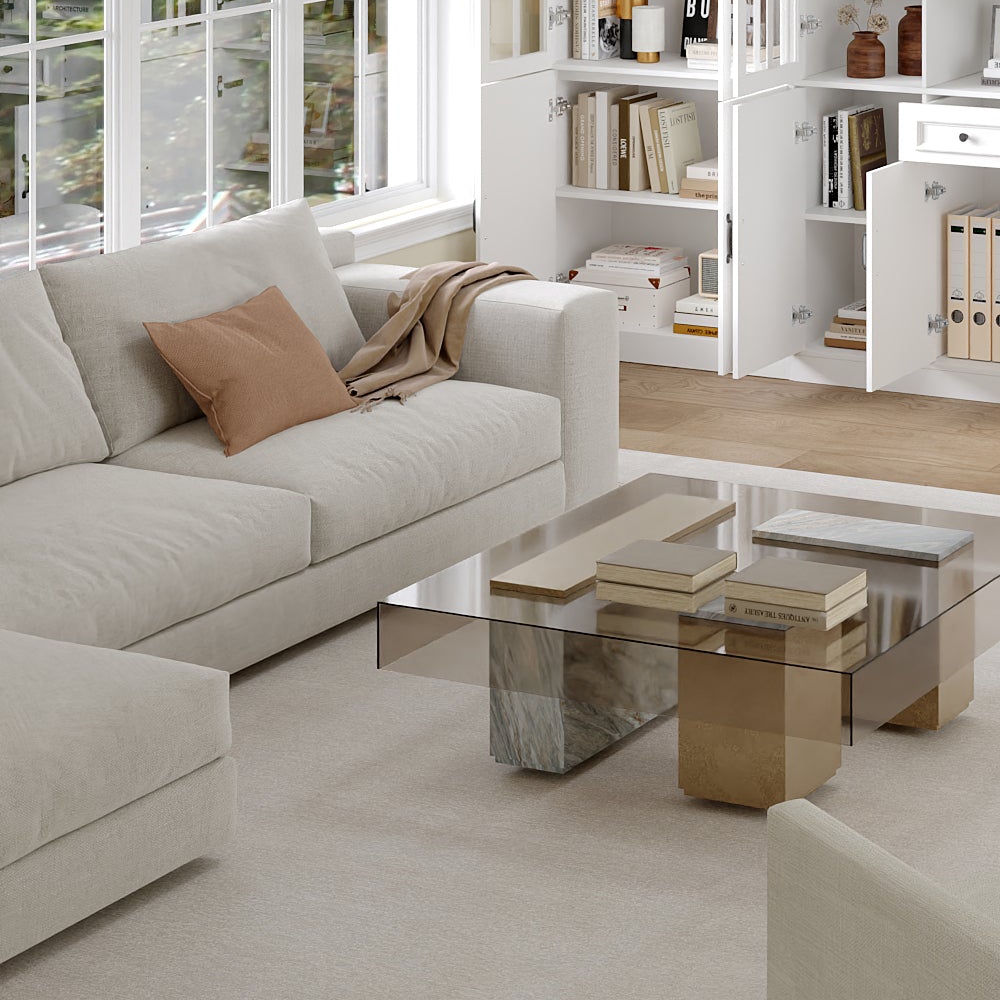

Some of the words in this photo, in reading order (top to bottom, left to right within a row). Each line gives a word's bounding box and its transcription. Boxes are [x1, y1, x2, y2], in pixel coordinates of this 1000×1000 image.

[670, 115, 683, 127] LOST
[744, 607, 777, 618] TREASURY
[778, 612, 810, 623] ANTIQUES
